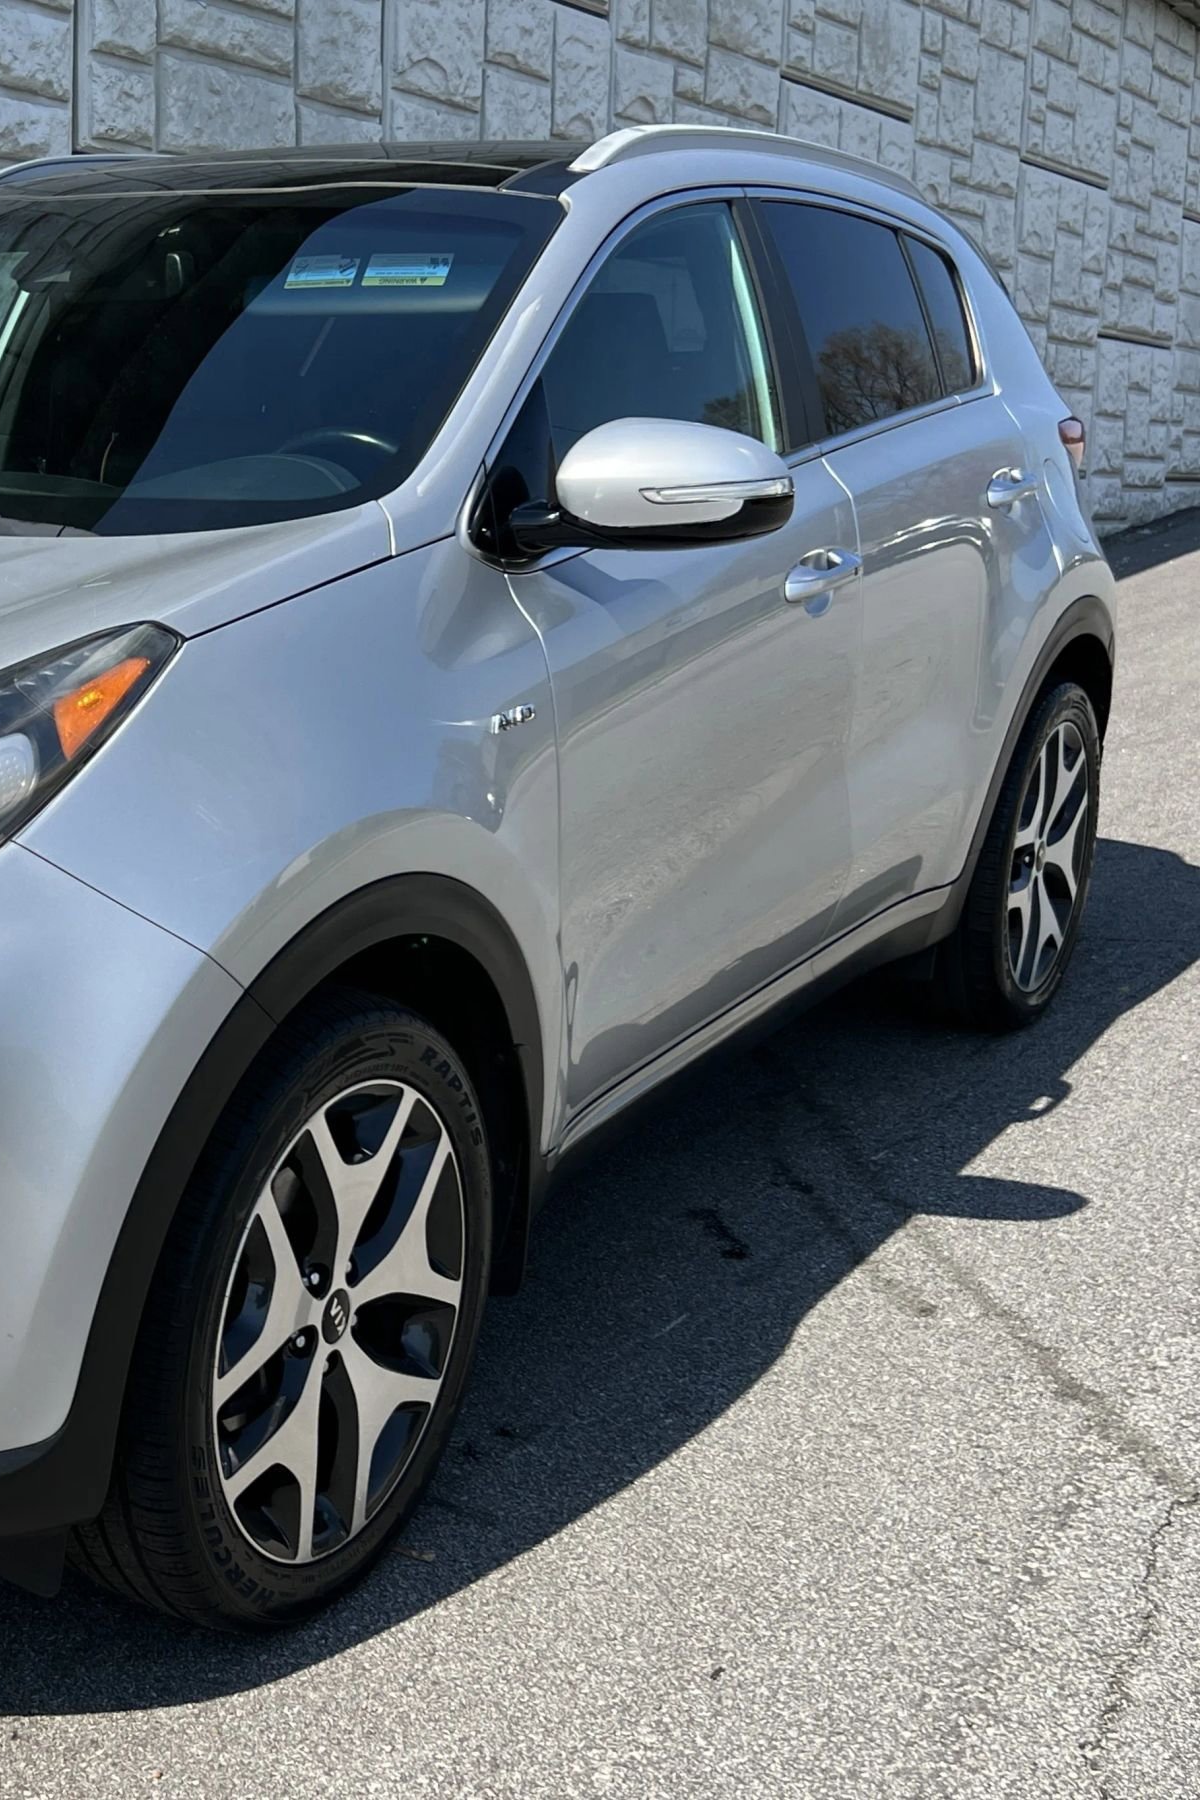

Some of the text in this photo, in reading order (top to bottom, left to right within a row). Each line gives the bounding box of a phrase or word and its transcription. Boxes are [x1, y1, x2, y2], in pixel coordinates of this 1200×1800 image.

[419, 1044, 483, 1147] RAPTIS
[330, 1296, 346, 1337] KIA
[192, 1445, 276, 1609] HERCULES
